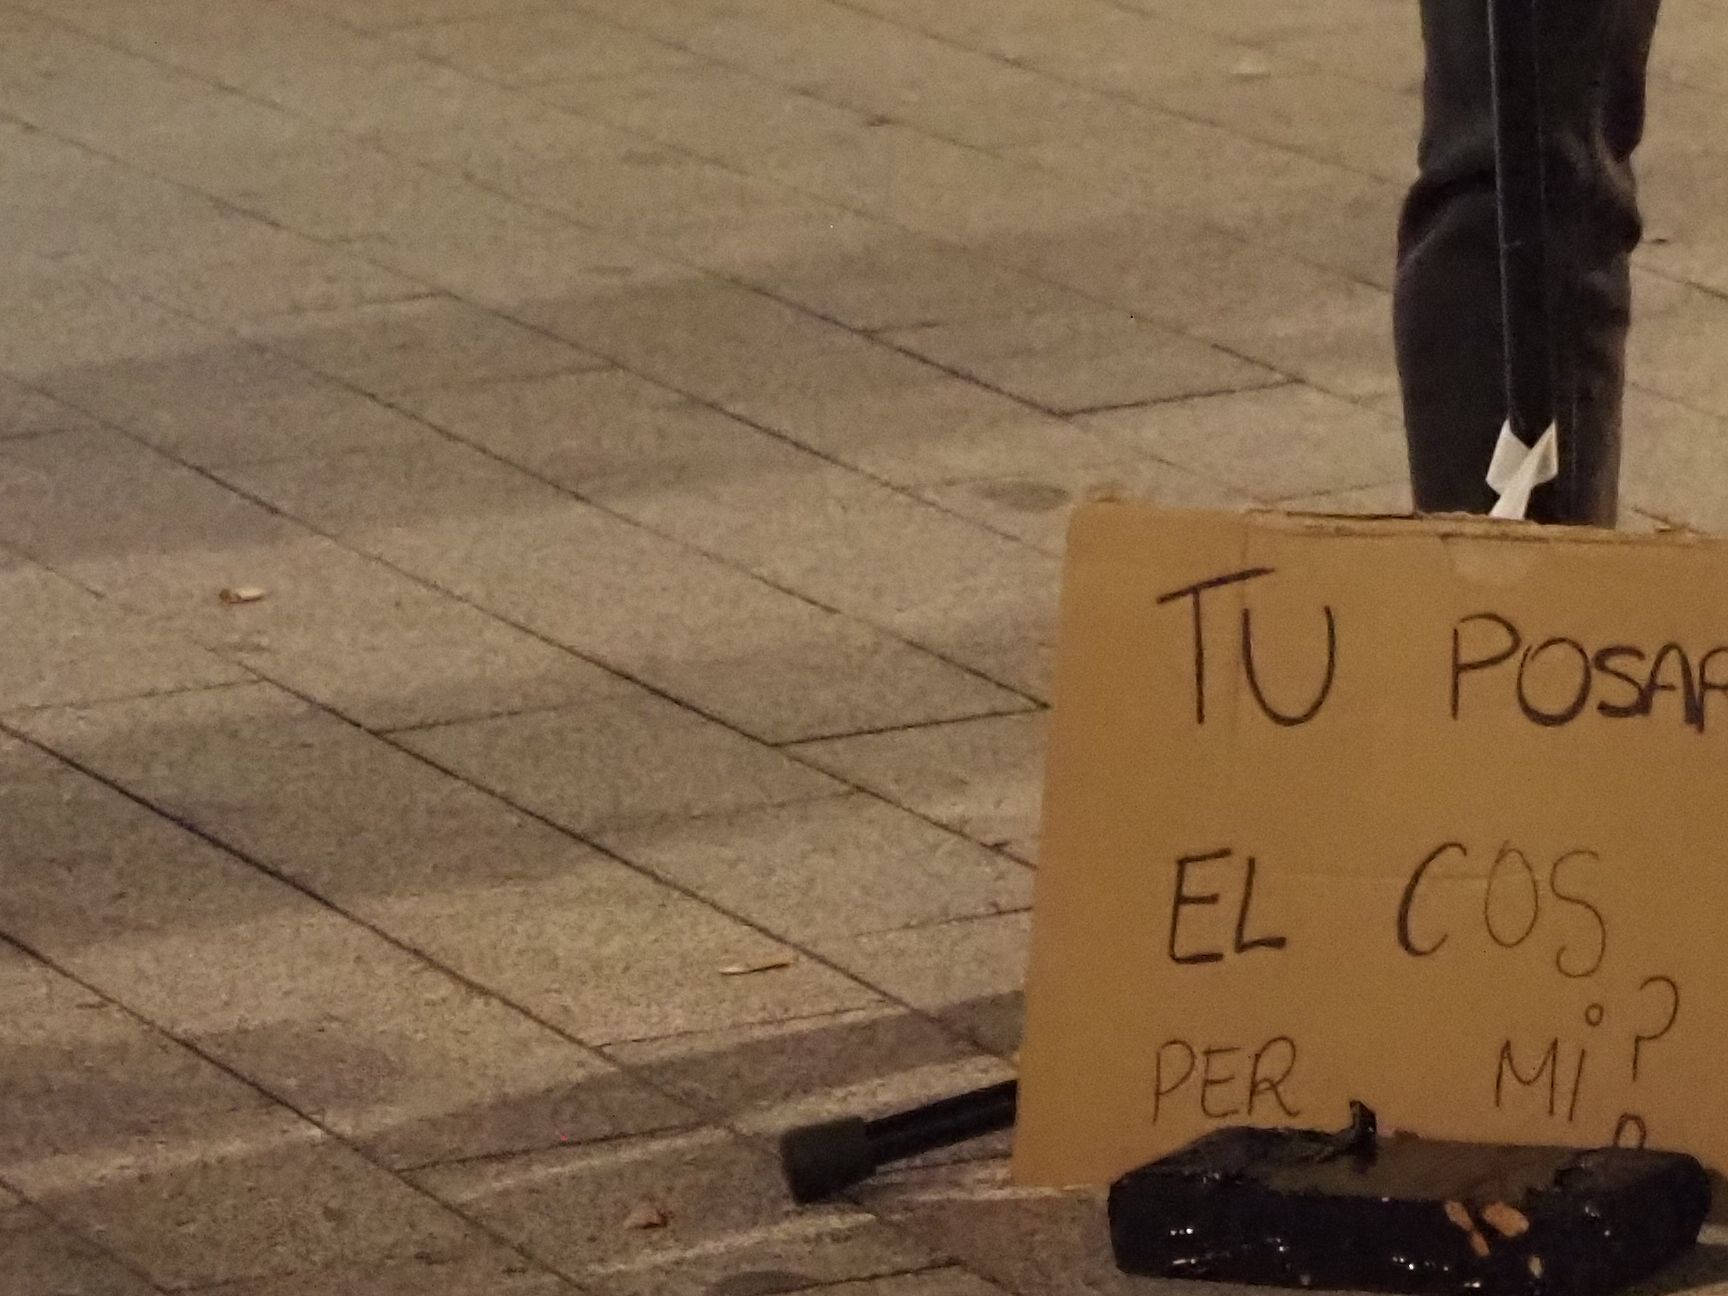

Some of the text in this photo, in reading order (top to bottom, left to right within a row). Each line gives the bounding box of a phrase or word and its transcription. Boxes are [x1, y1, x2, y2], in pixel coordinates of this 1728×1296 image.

[1156, 567, 1336, 727] TU
[1167, 842, 1608, 979] EL COS
[1153, 1036, 1302, 1126] PER
